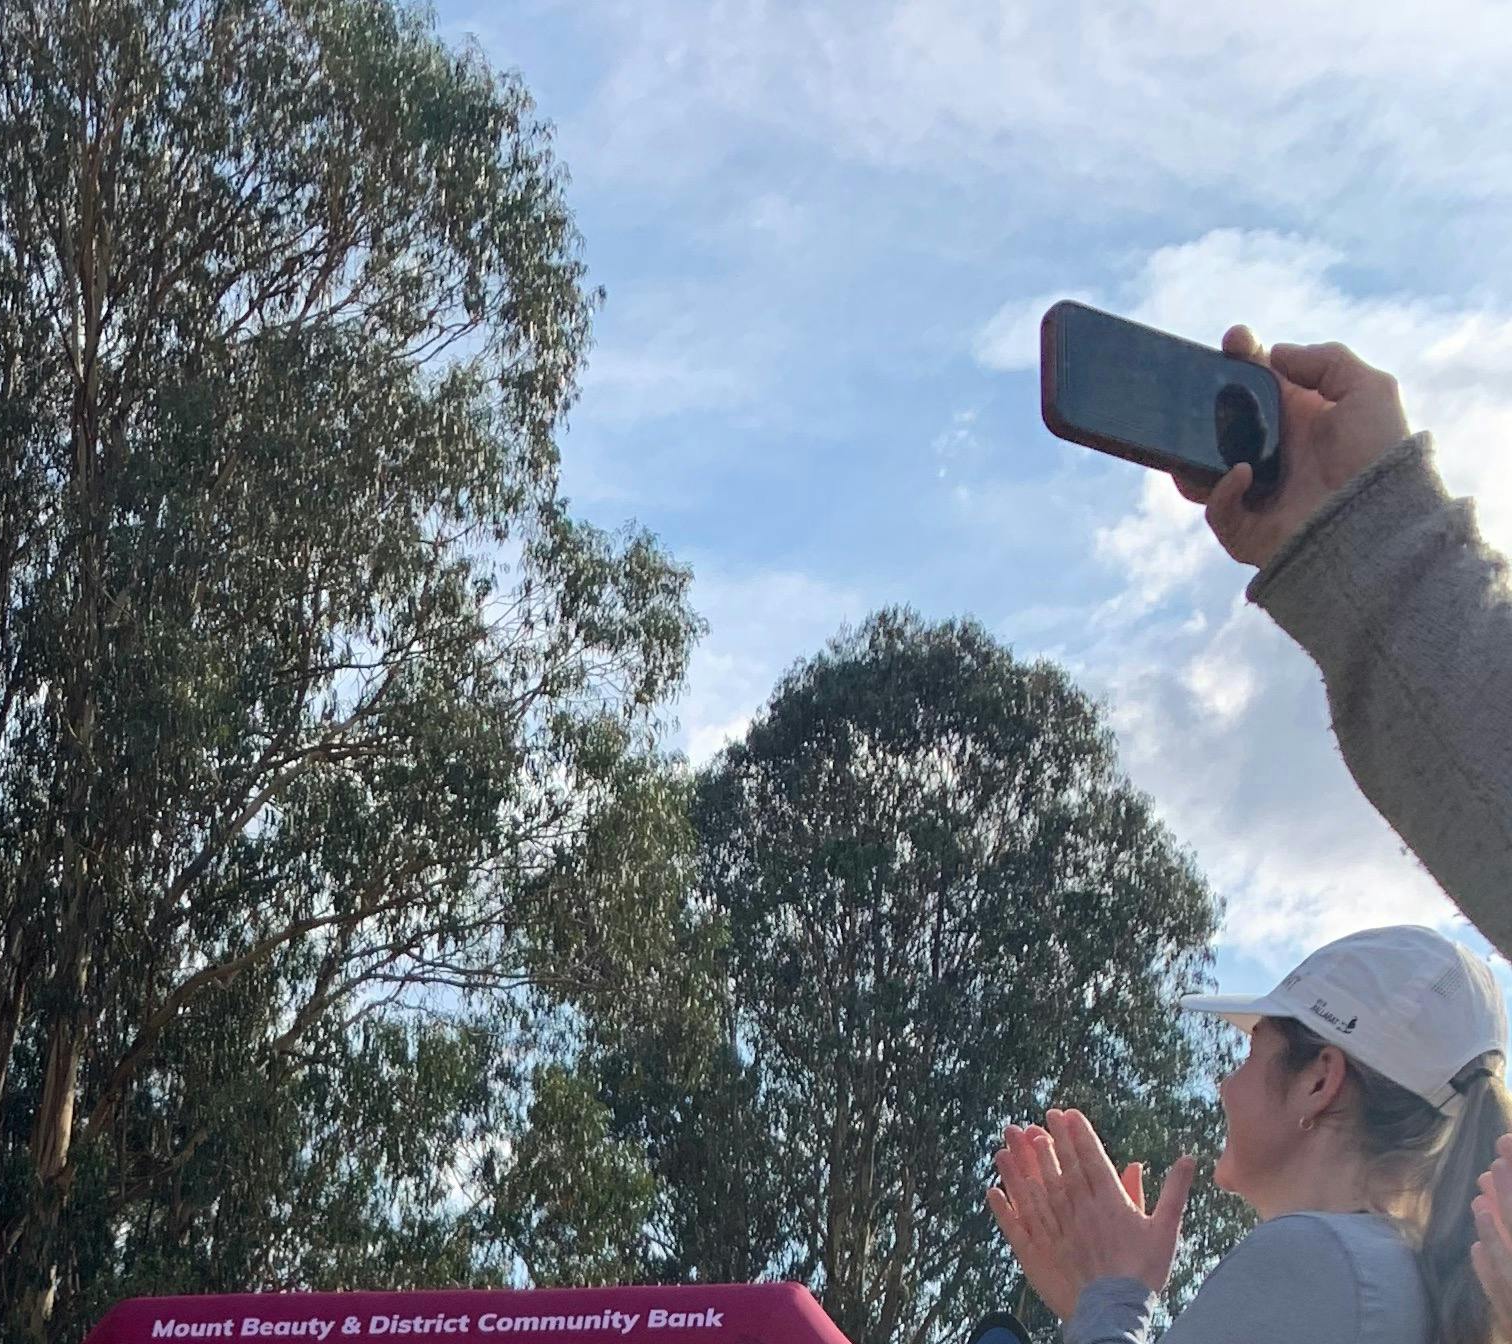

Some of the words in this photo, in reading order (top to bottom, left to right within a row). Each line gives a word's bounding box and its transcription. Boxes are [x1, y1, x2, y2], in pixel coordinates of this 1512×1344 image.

[151, 1319, 234, 1338] Mount
[240, 1317, 335, 1341] Beauty
[341, 1315, 361, 1335] &
[368, 1313, 471, 1335] District
[477, 1309, 640, 1335] Community
[647, 1308, 725, 1328] Bank
